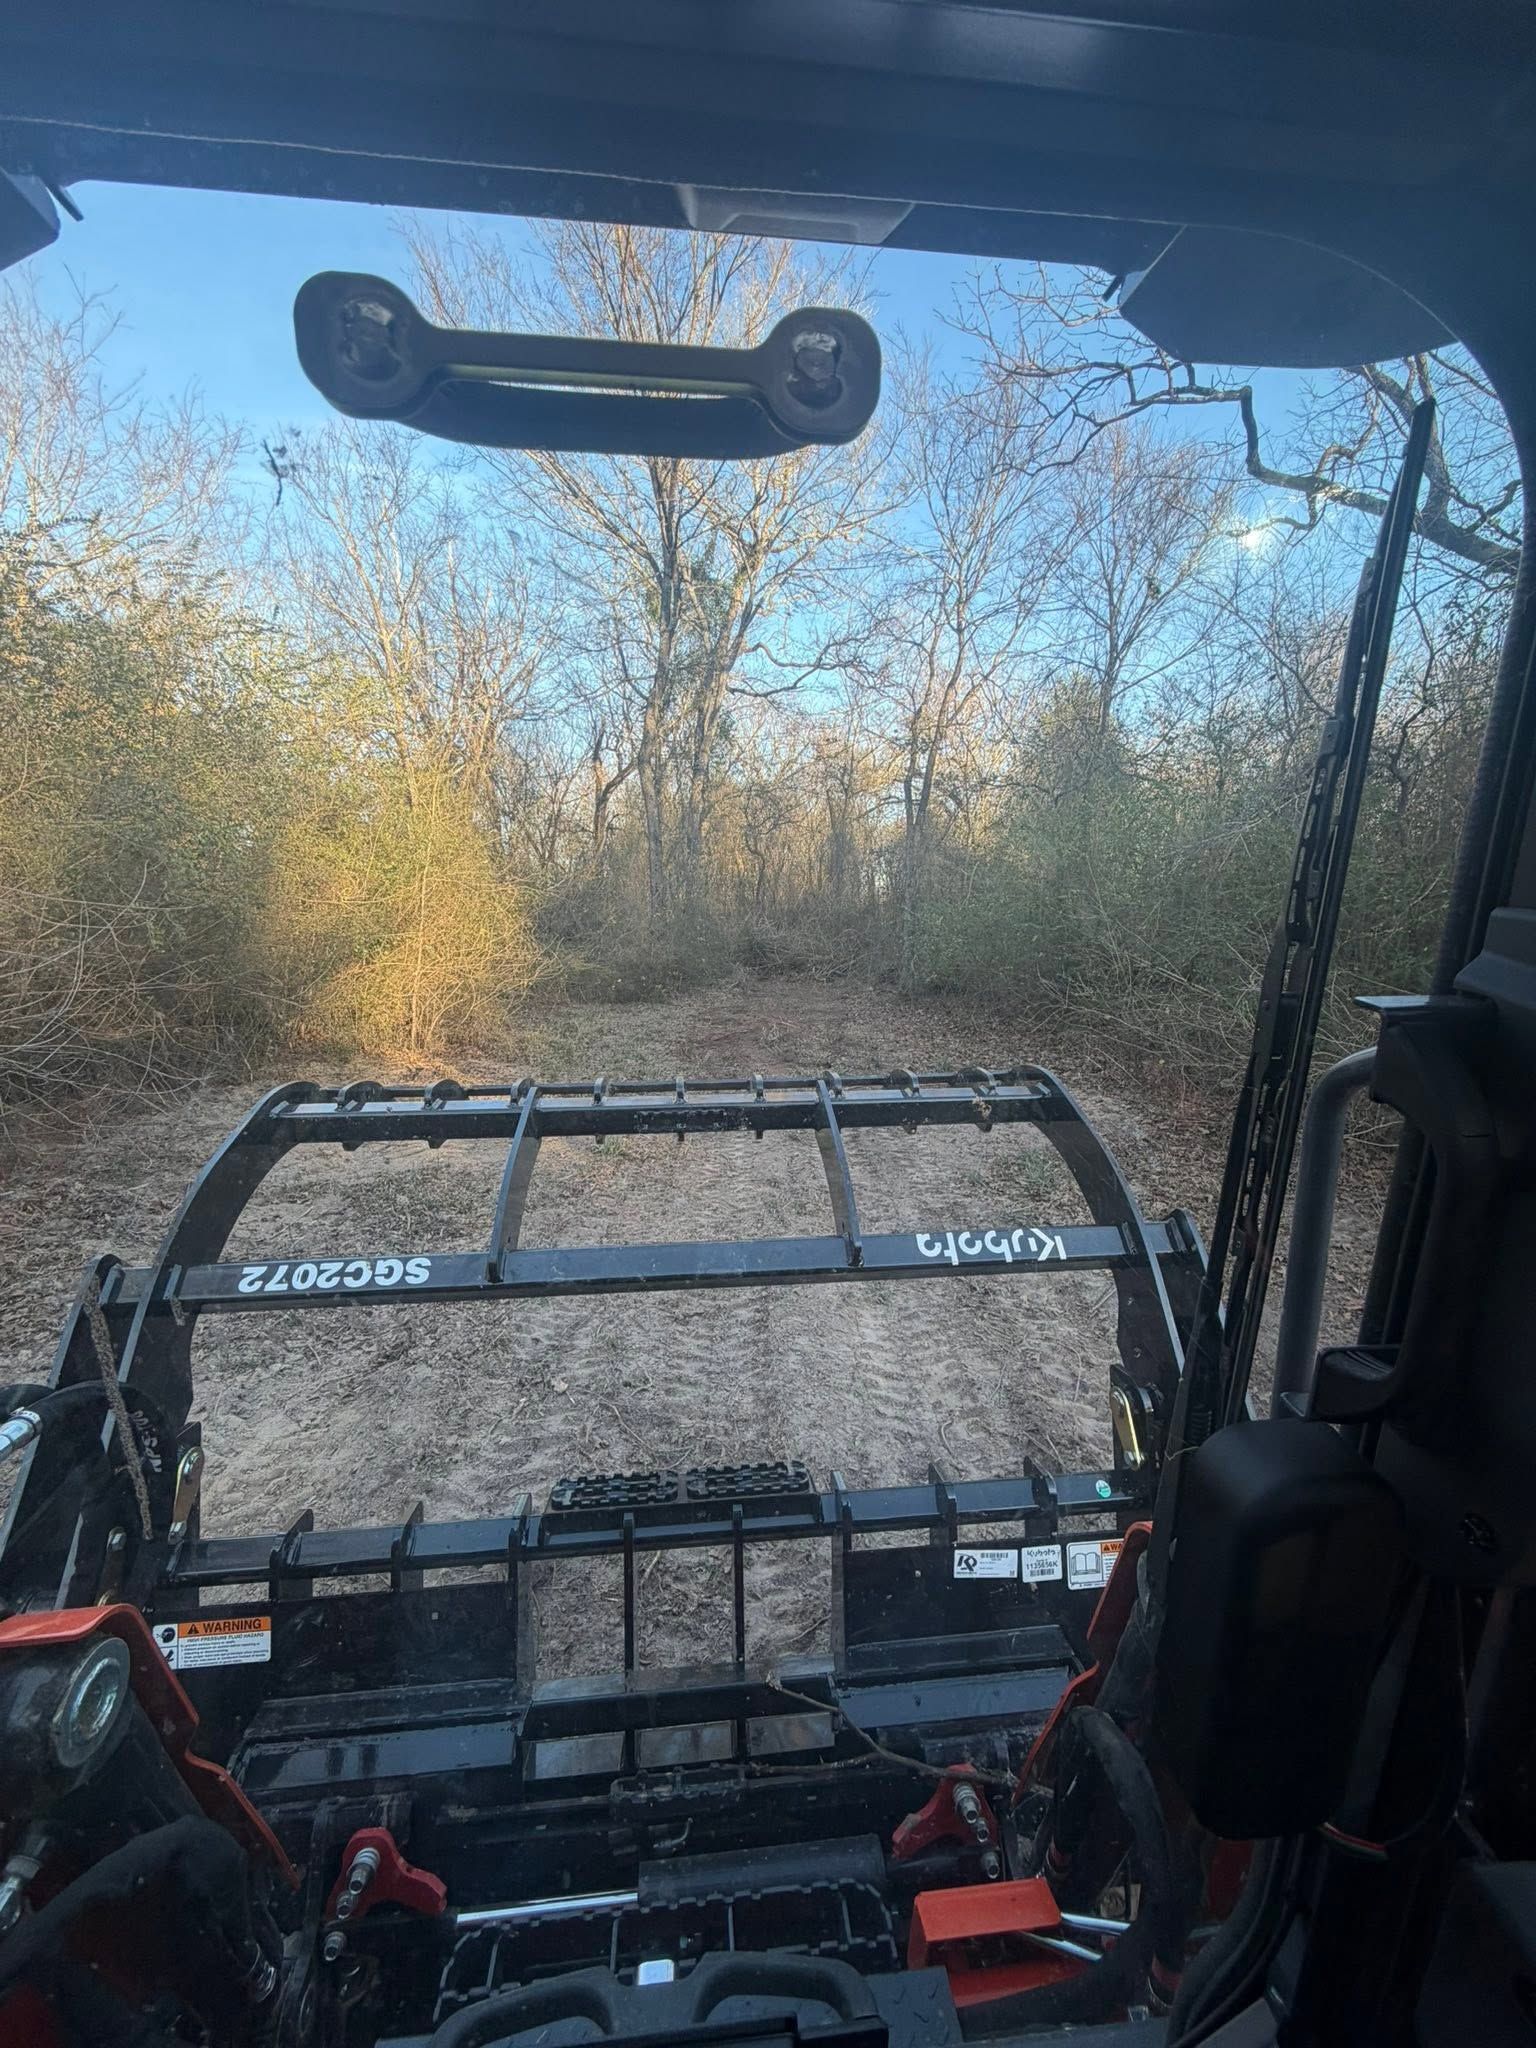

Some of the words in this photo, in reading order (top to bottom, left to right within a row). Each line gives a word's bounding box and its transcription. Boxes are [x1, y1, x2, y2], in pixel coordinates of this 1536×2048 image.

[916, 1228, 1067, 1266] Kubota
[238, 1257, 432, 1293] SGC2072
[203, 1618, 262, 1634] WARNING
